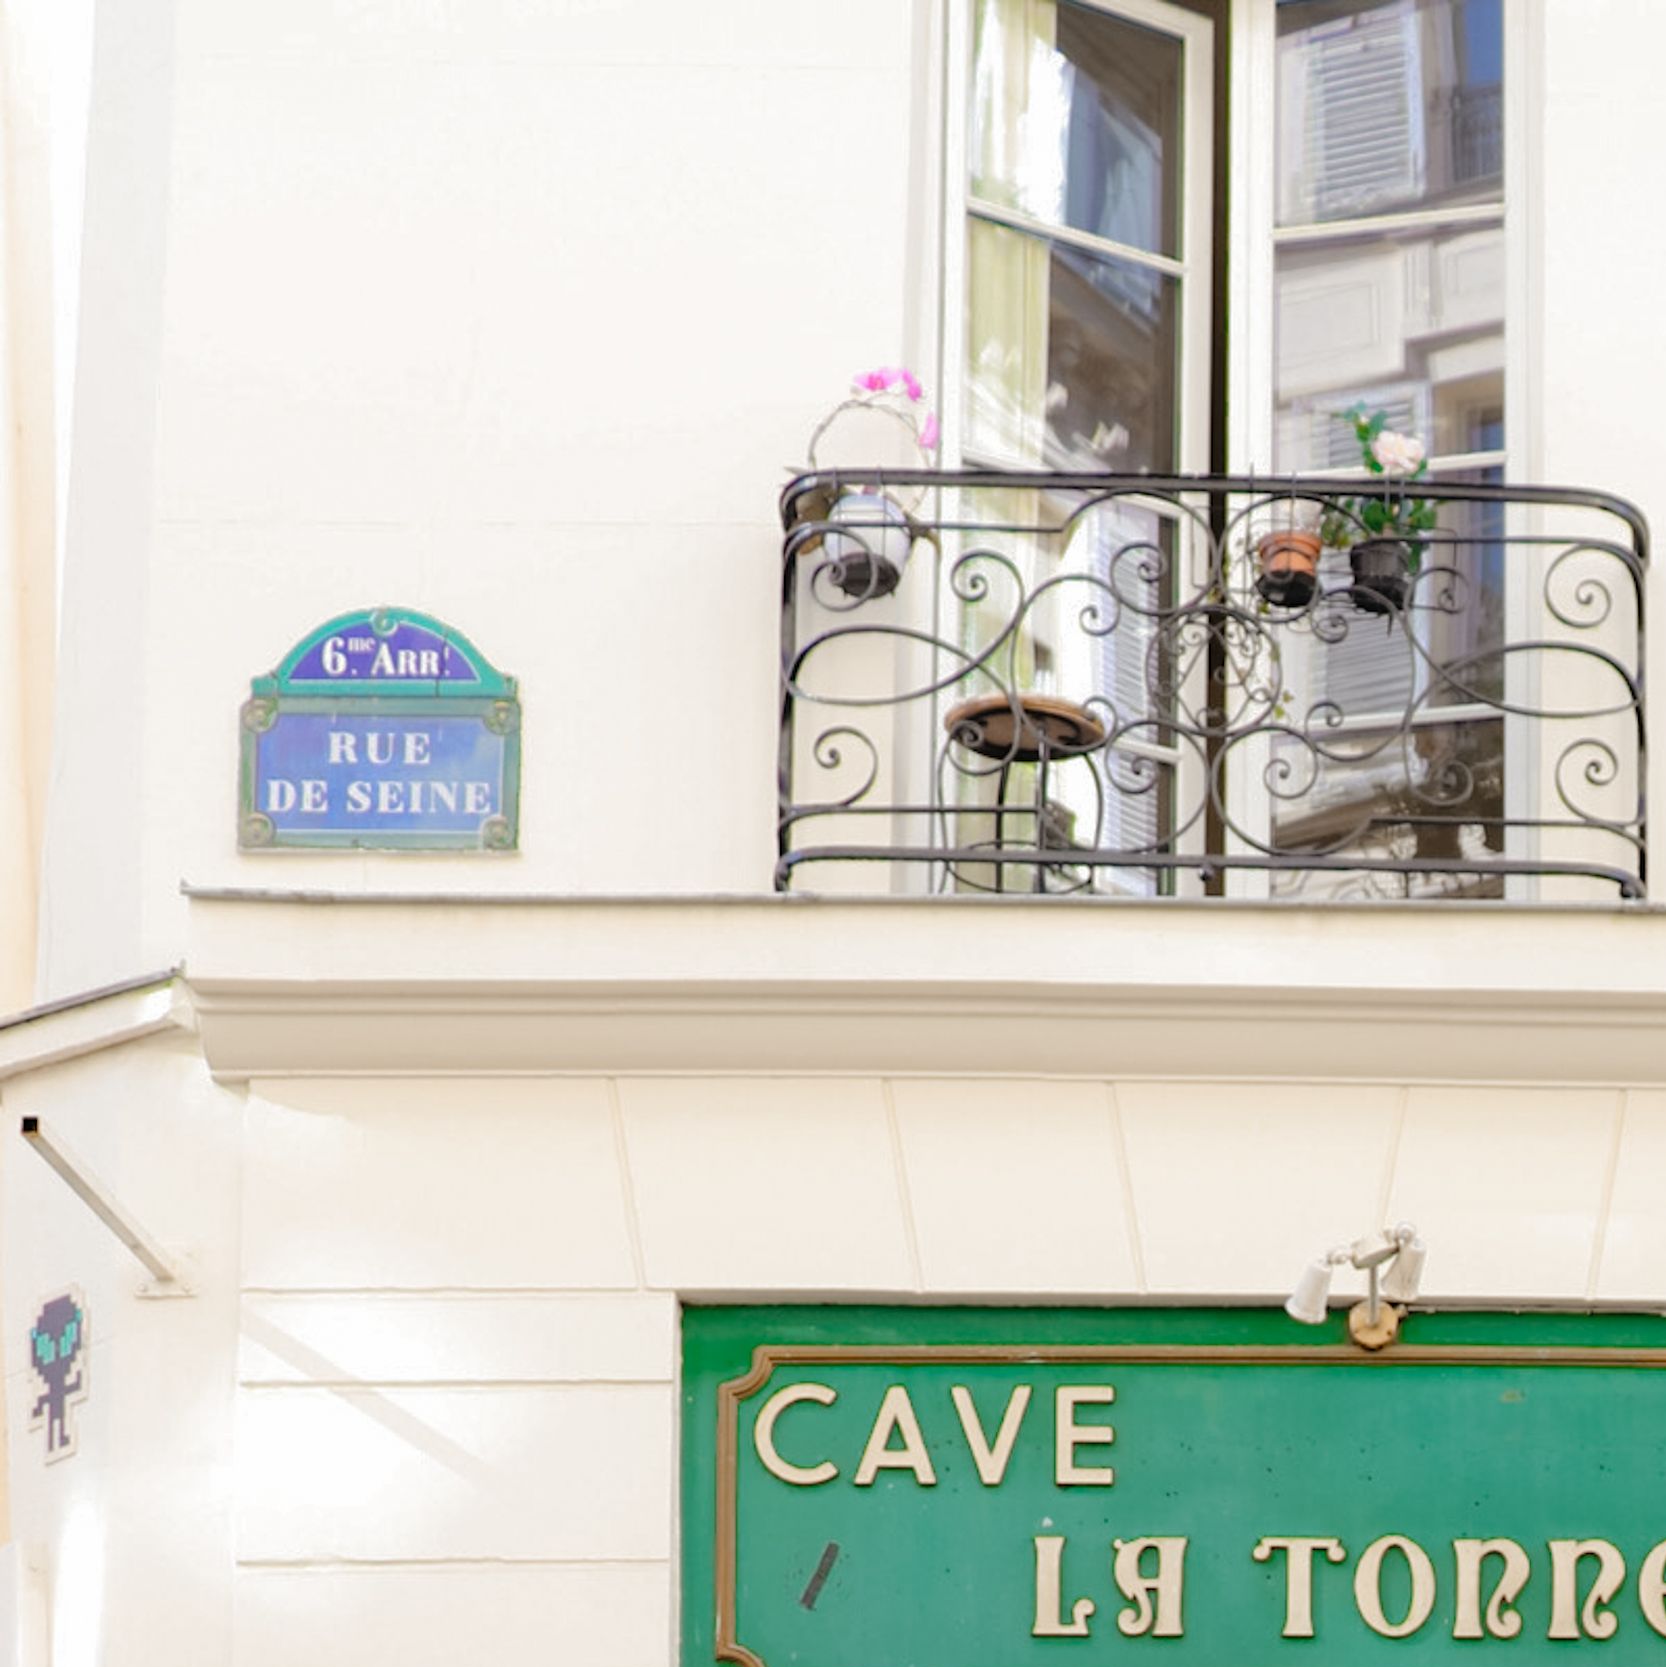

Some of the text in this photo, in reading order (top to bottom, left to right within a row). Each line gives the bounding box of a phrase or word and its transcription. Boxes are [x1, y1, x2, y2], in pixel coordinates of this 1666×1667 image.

[328, 731, 431, 765] RUE
[266, 778, 491, 814] DE SEINE
[753, 1383, 1115, 1485] CAVE
[1032, 1536, 1188, 1636] LA
